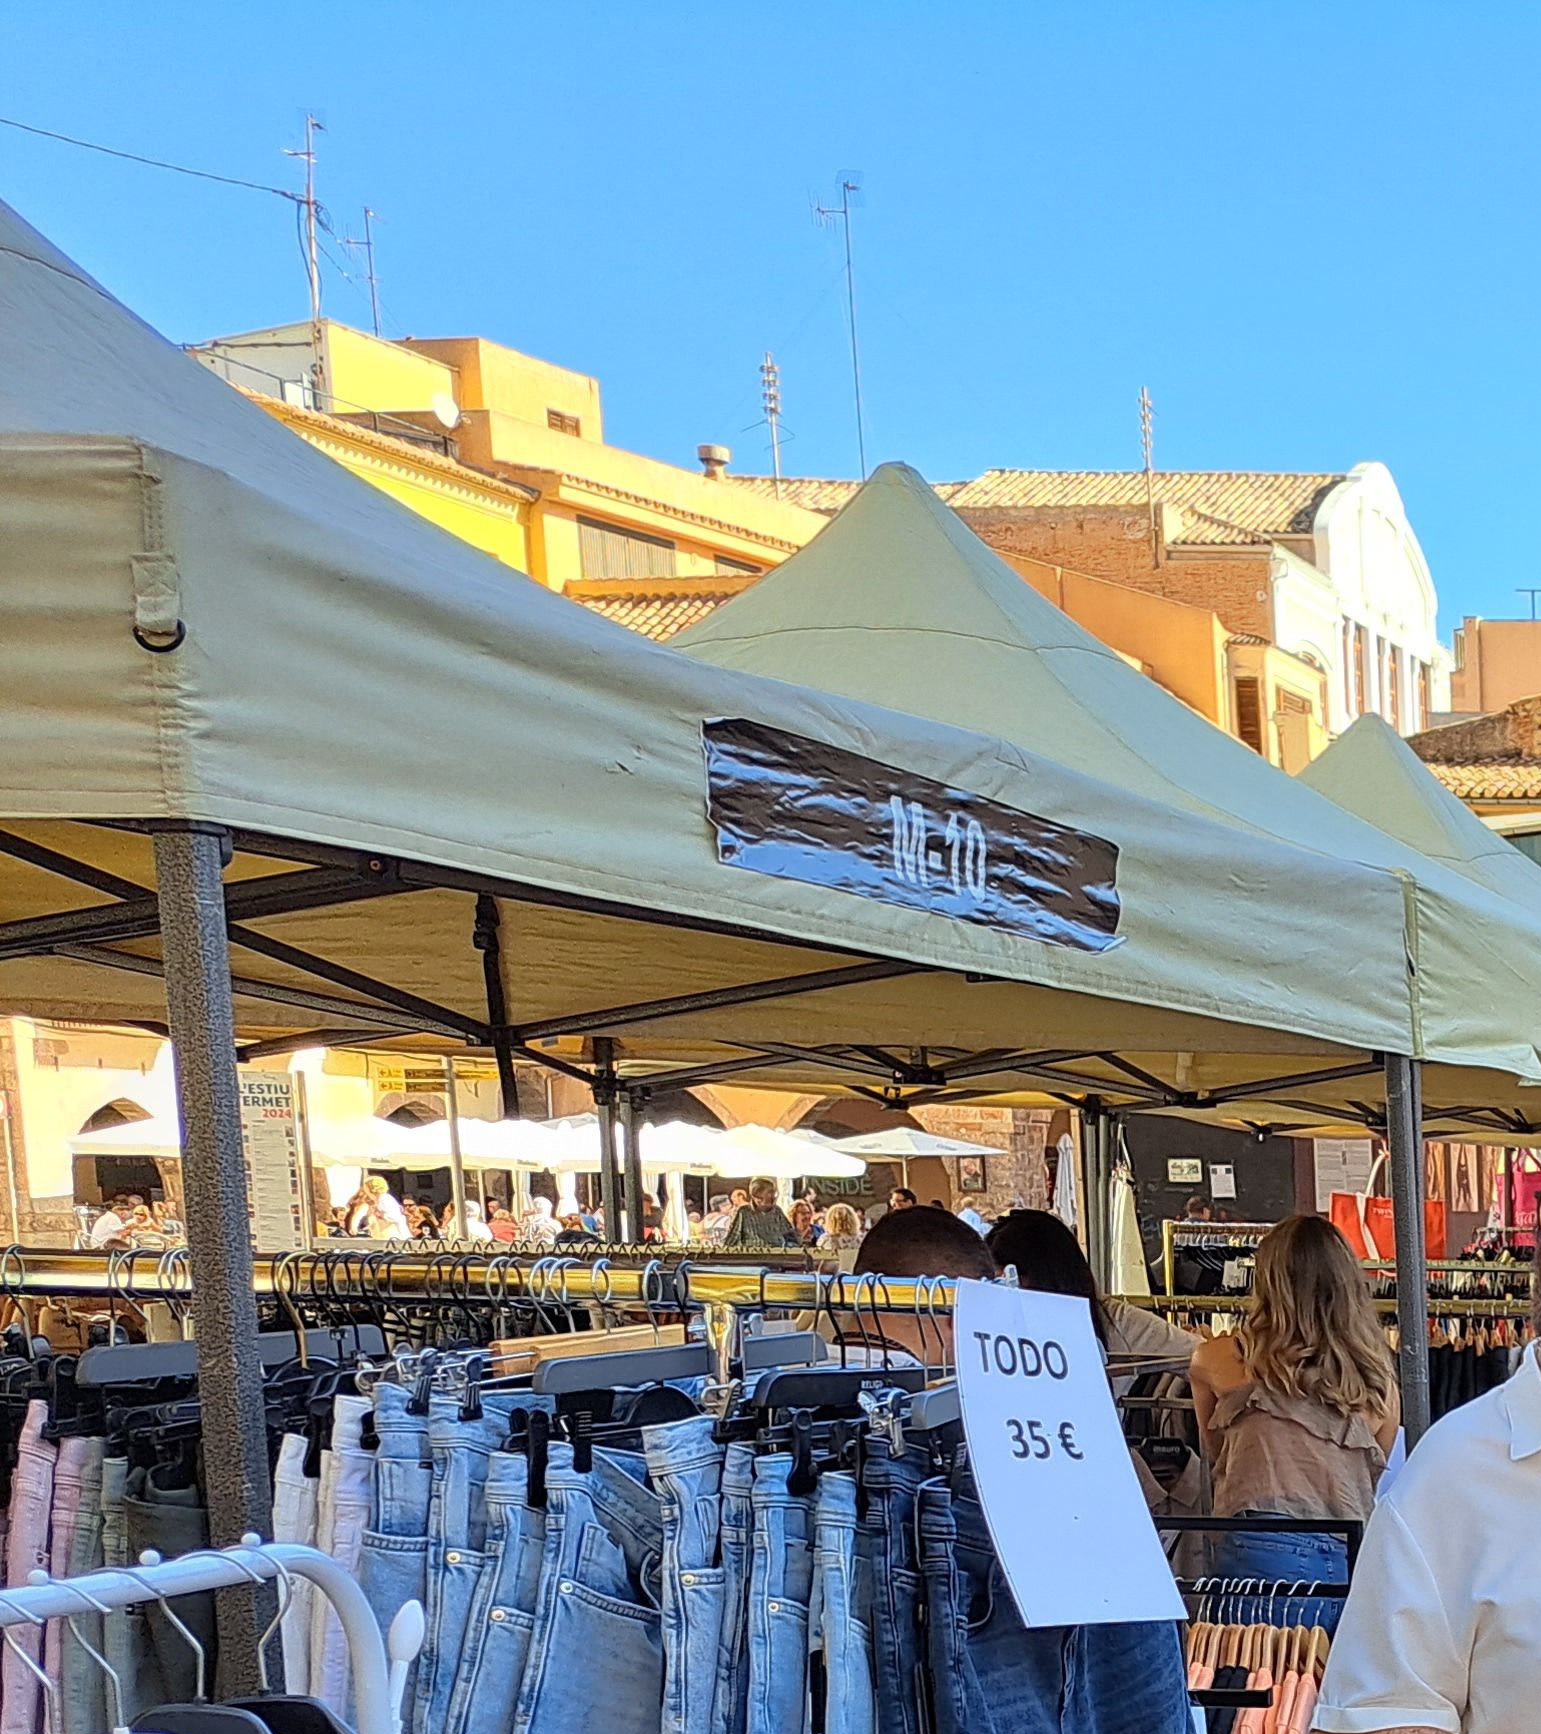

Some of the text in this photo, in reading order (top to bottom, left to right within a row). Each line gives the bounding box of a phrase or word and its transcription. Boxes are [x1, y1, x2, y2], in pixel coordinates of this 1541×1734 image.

[241, 1096, 291, 1107] ERMET
[262, 1108, 292, 1119] 2024
[973, 1331, 1069, 1380] TODO
